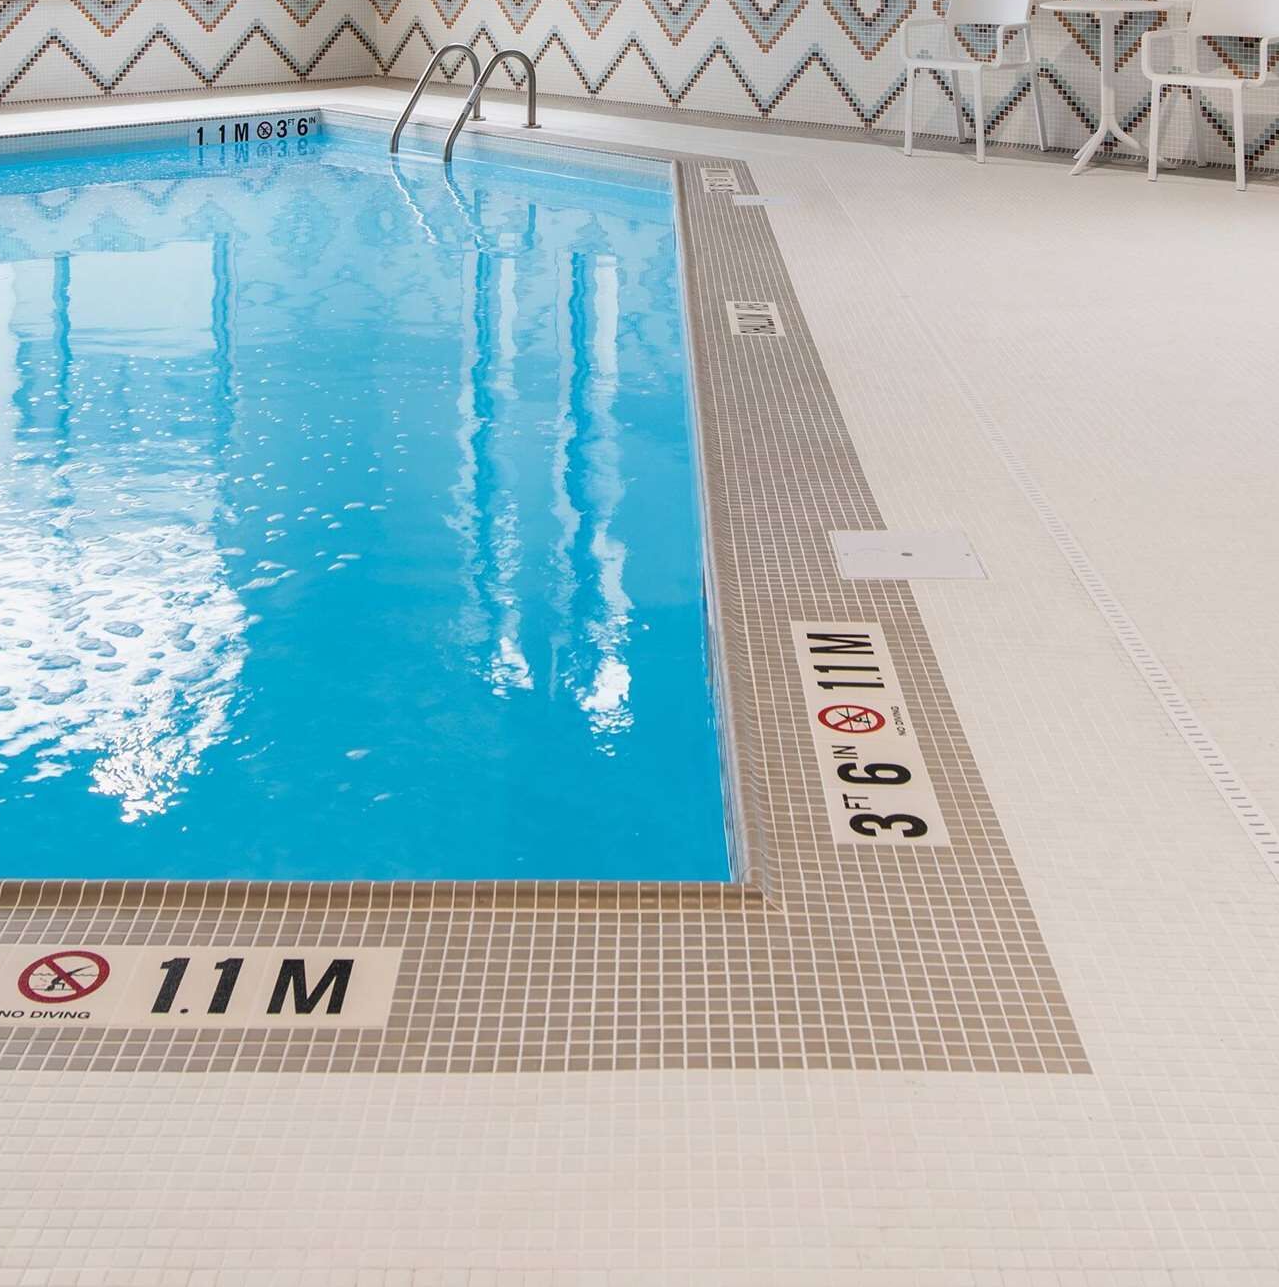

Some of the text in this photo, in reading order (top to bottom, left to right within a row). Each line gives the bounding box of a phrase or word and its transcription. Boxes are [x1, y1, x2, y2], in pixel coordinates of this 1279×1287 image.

[235, 123, 249, 143] M
[806, 633, 875, 655] M
[150, 957, 245, 1016] 1.1
[266, 958, 355, 1016] M
[29, 1010, 91, 1020] DIVING
